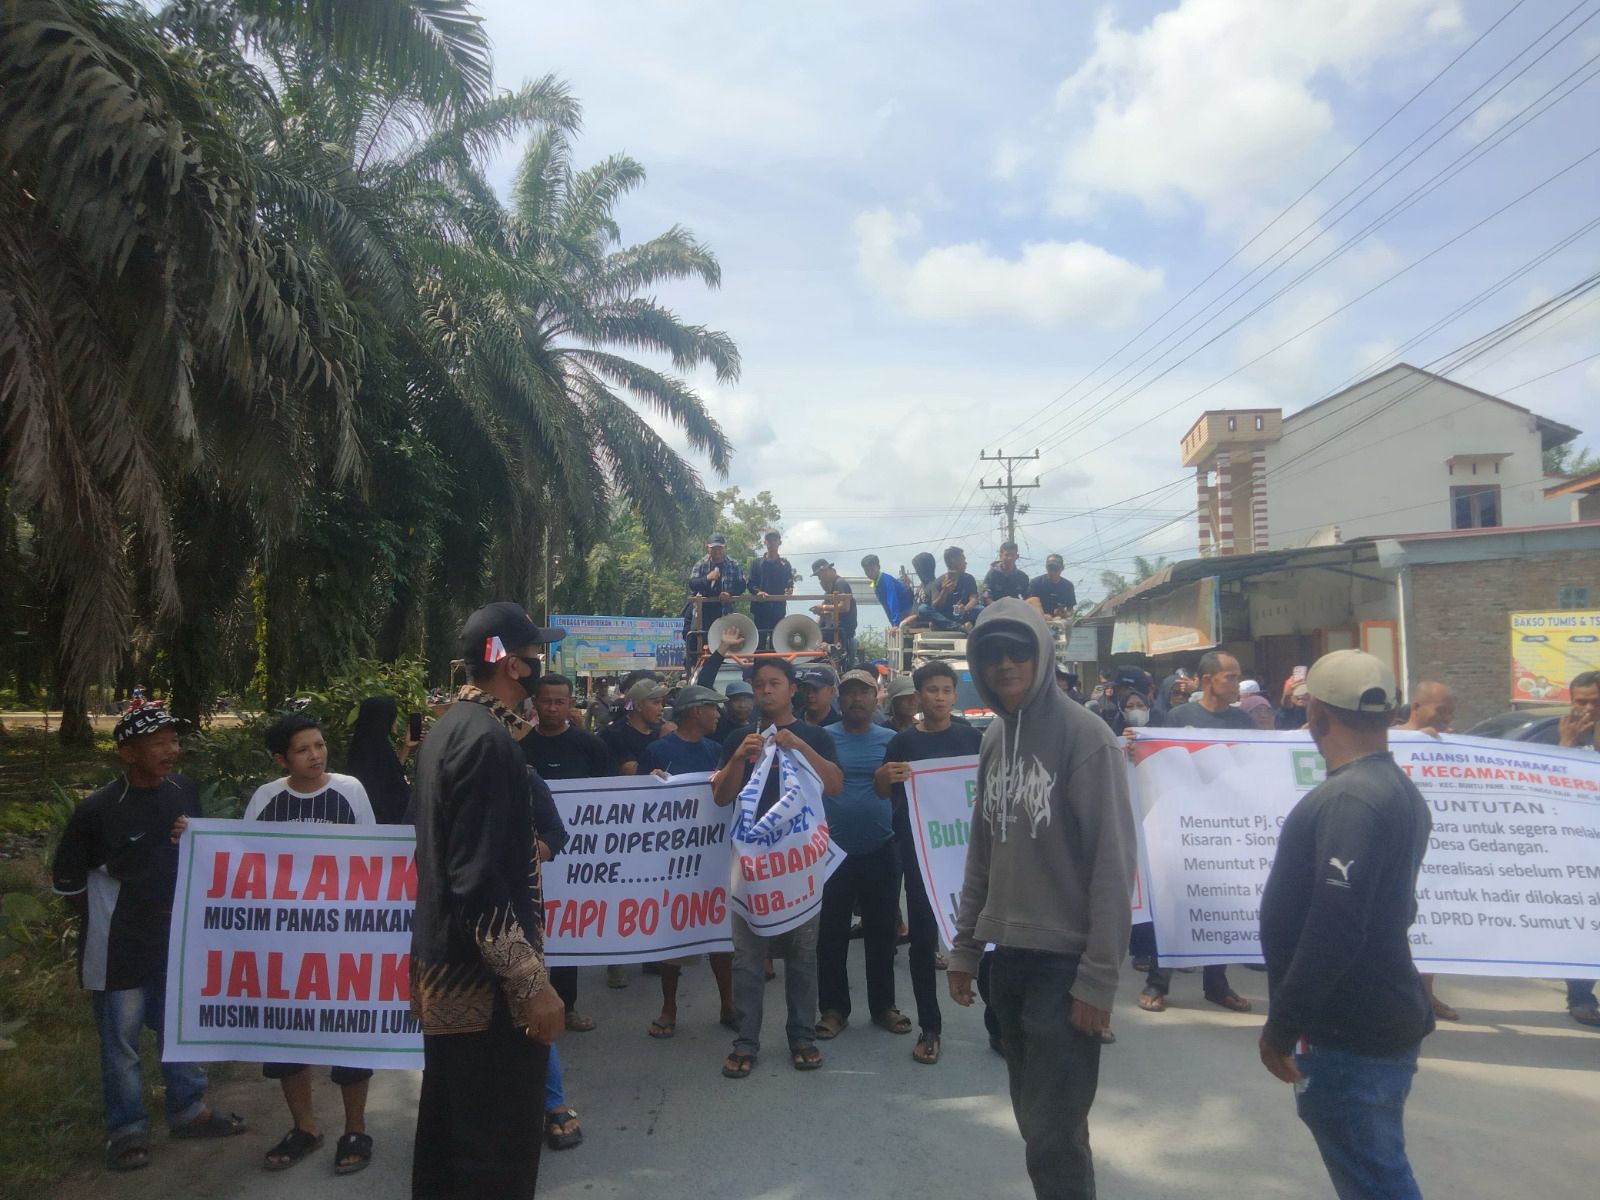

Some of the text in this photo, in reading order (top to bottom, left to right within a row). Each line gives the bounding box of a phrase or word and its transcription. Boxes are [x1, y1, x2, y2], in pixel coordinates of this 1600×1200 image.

[1514, 617, 1545, 627] BAKSO
[1547, 616, 1577, 627] TUMIS
[1410, 752, 1568, 774] ALIANSI MASYARAKAT
[1422, 765, 1543, 785] KECAMATAN
[1547, 774, 1600, 793] BERS
[568, 798, 699, 826] JALAN KAMI
[1180, 815, 1250, 829] Menuntut
[1254, 816, 1272, 832] Pj.
[1463, 821, 1505, 835] untuk
[1509, 824, 1558, 839] segera
[604, 822, 726, 855] DIPERBAIKI
[1181, 832, 1232, 847] Kisaran
[1430, 837, 1549, 856] Desa Gedangan.
[1184, 857, 1255, 871] Menuntut
[1422, 861, 1495, 877] terealisasi
[1498, 864, 1563, 879] sebelum
[1187, 883, 1252, 898] Meminta
[1435, 889, 1479, 903] untuk
[1482, 888, 1521, 904] hadir
[1525, 890, 1585, 906] dilokasi
[203, 906, 413, 933] MUSIM PANAS MAKAN
[544, 886, 727, 938] TAPI BO'ONG
[1189, 908, 1260, 922] Menuntut
[1432, 911, 1474, 926] DPRD
[1478, 914, 1517, 928] Prov.
[1521, 914, 1575, 930] Sumut
[199, 1004, 259, 1028] MUSIM
[263, 1006, 315, 1032] HUJAN
[319, 1008, 377, 1034] MANDI
